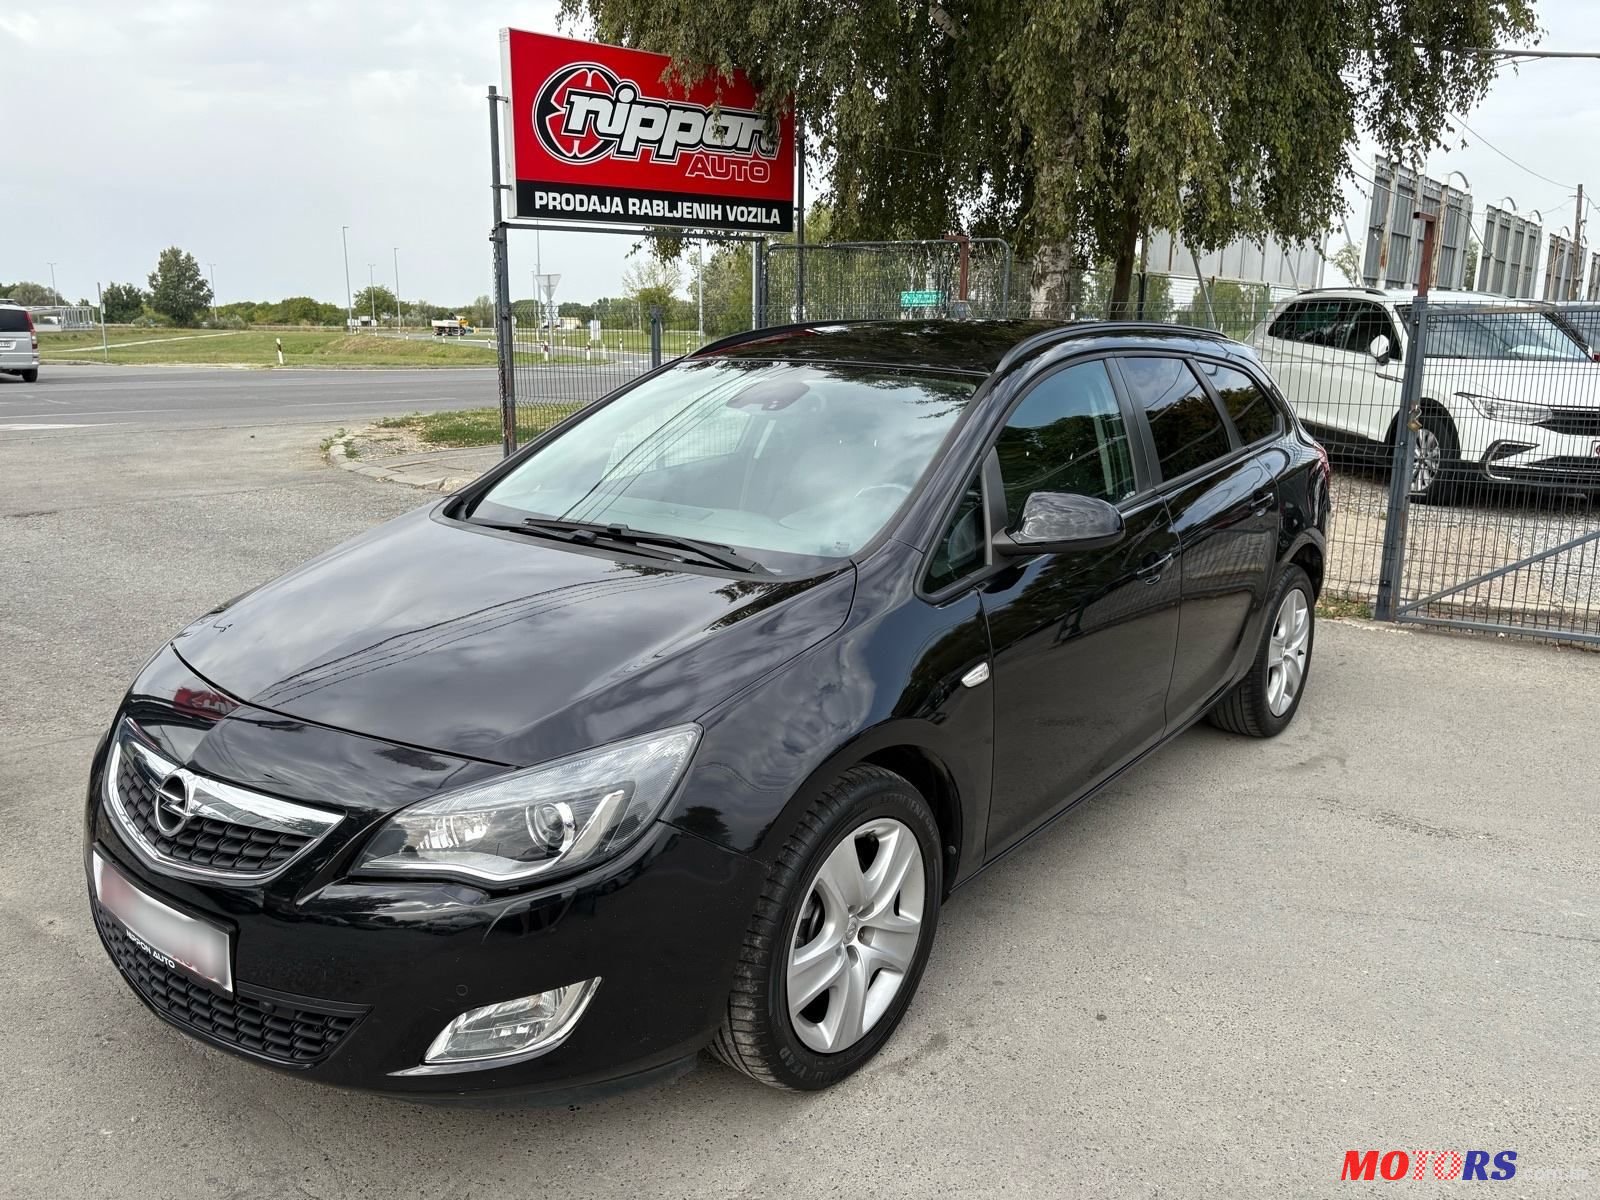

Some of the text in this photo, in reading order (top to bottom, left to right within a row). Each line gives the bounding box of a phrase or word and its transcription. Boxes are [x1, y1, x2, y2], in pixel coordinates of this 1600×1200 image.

[686, 154, 770, 183] AUTO
[534, 190, 781, 225] PRODAJA RABLJENIH VOZILA
[153, 951, 175, 968] AUTO
